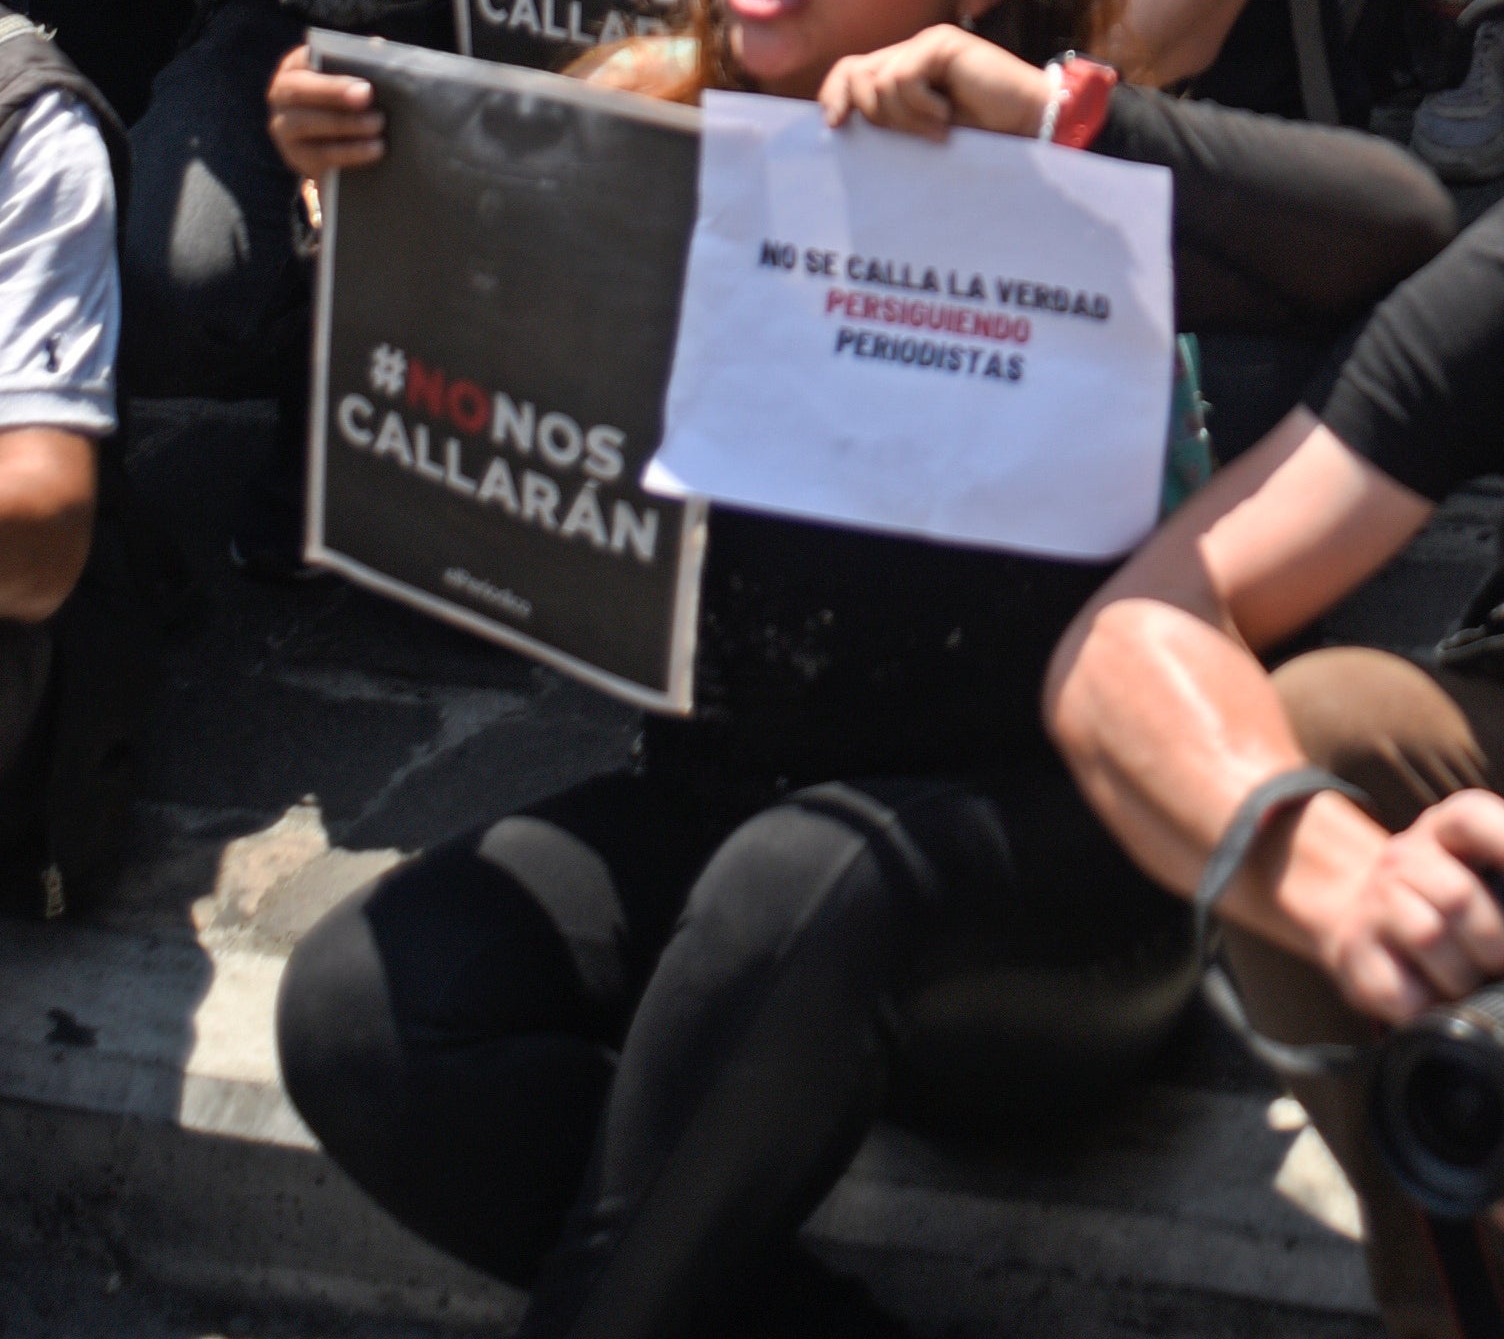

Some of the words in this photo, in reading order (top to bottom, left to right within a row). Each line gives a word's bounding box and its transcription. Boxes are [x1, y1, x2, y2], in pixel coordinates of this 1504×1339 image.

[758, 240, 797, 269] NO
[804, 248, 840, 277] SE
[846, 255, 940, 294] CALLA
[949, 269, 985, 299] LA
[996, 274, 1110, 320] VERDAD
[824, 286, 1030, 345] PERSIGUIENDO
[834, 326, 1026, 384] PERIODISTAS
[369, 341, 628, 483] #NONOS
[336, 393, 660, 562] CALLARÁN
